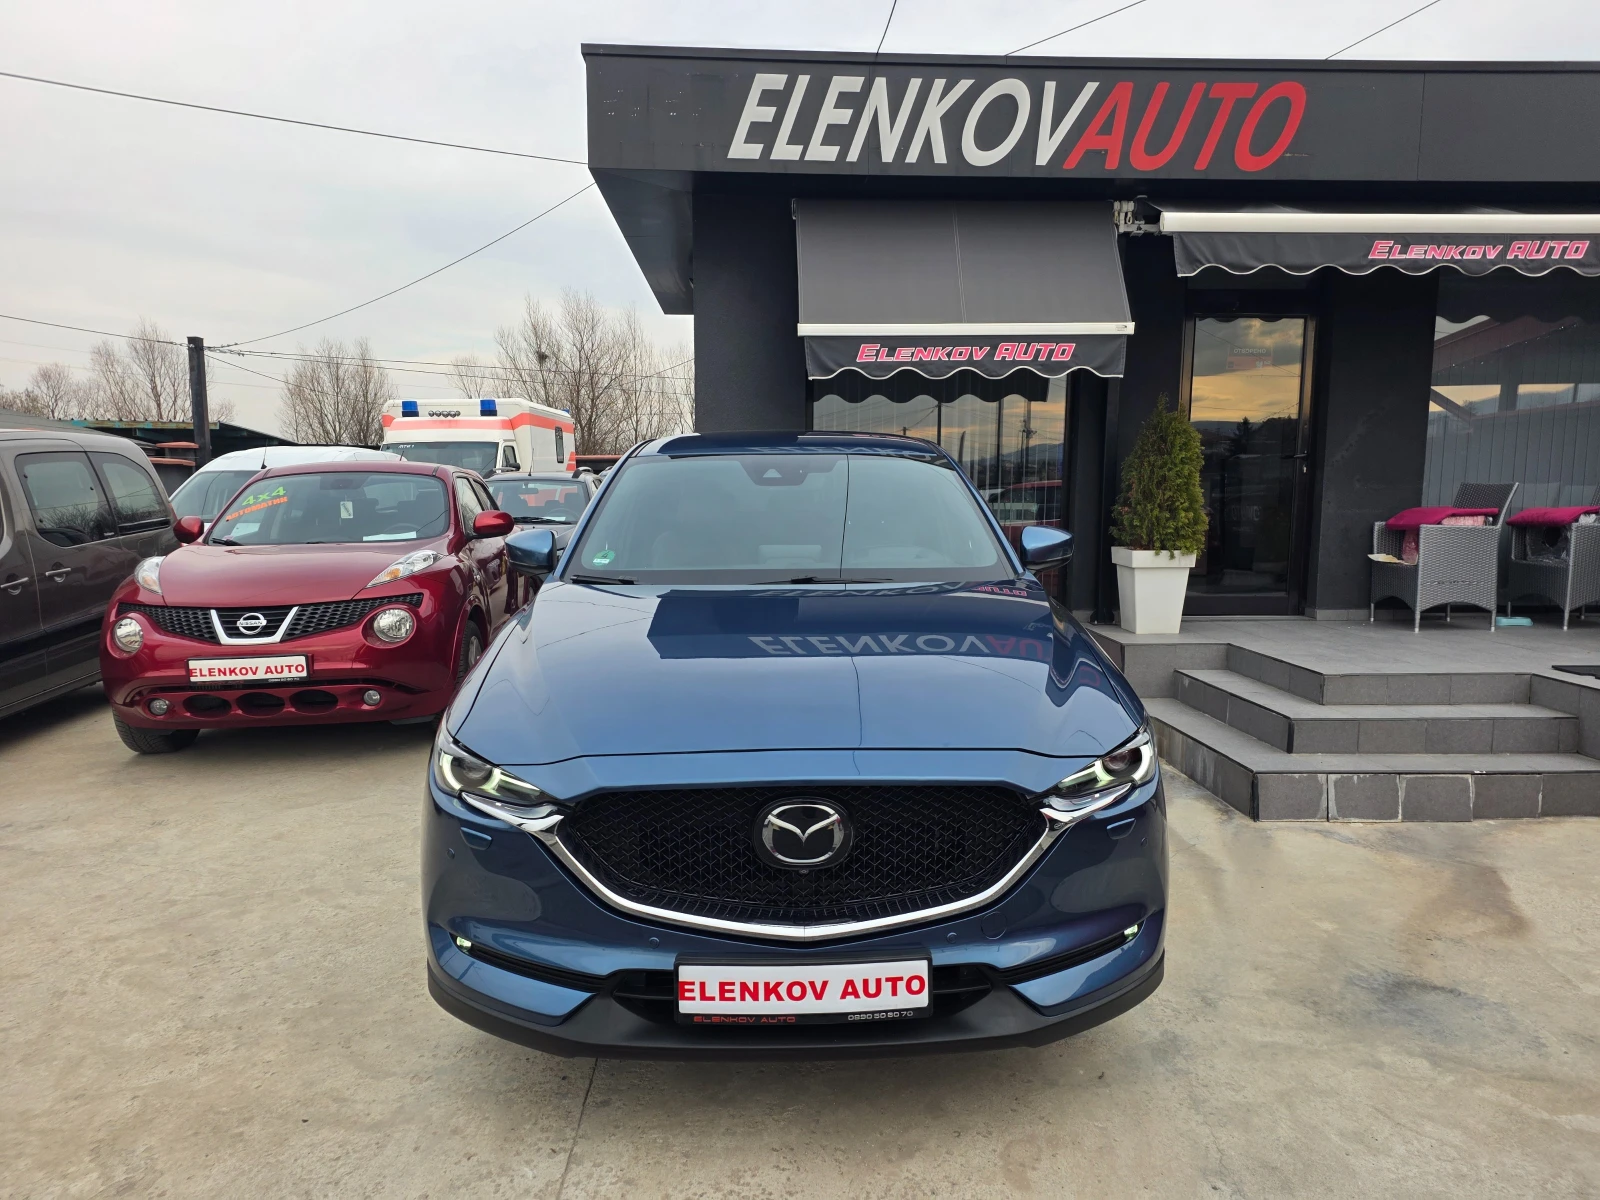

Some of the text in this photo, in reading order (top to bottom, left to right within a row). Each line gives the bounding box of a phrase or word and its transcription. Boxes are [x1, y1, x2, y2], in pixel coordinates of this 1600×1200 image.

[1506, 240, 1590, 259] AUTO
[994, 342, 1076, 361] AUTO
[189, 663, 306, 678] ELENKOV AUTO
[678, 974, 927, 1002] ELENKOV AUTO
[693, 1015, 756, 1024] ELENKOV
[760, 1015, 796, 1024] AUTO
